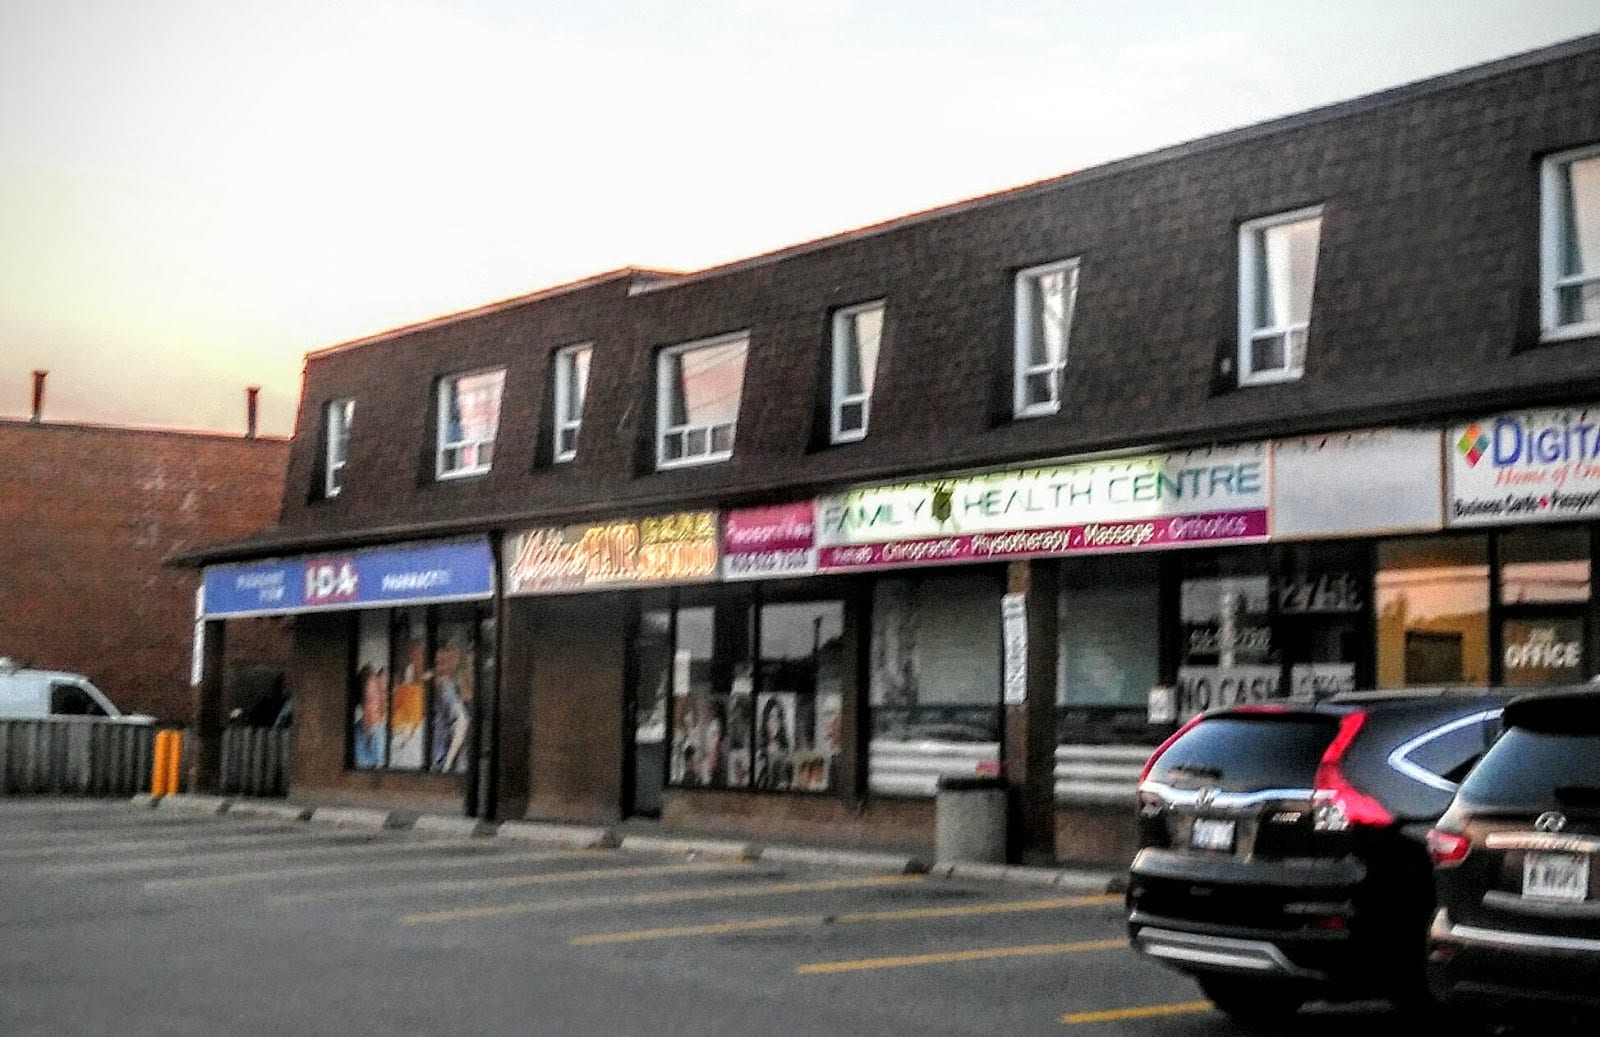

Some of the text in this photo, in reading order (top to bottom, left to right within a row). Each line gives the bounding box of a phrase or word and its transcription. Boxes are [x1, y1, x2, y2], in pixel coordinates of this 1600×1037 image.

[822, 494, 926, 534] FAMILY
[963, 478, 1092, 519] HEALTH
[1108, 462, 1261, 503] CENTRE
[882, 537, 962, 571] Chiropractic
[971, 529, 1071, 560] Physiotherapy
[1084, 522, 1155, 548] Massage
